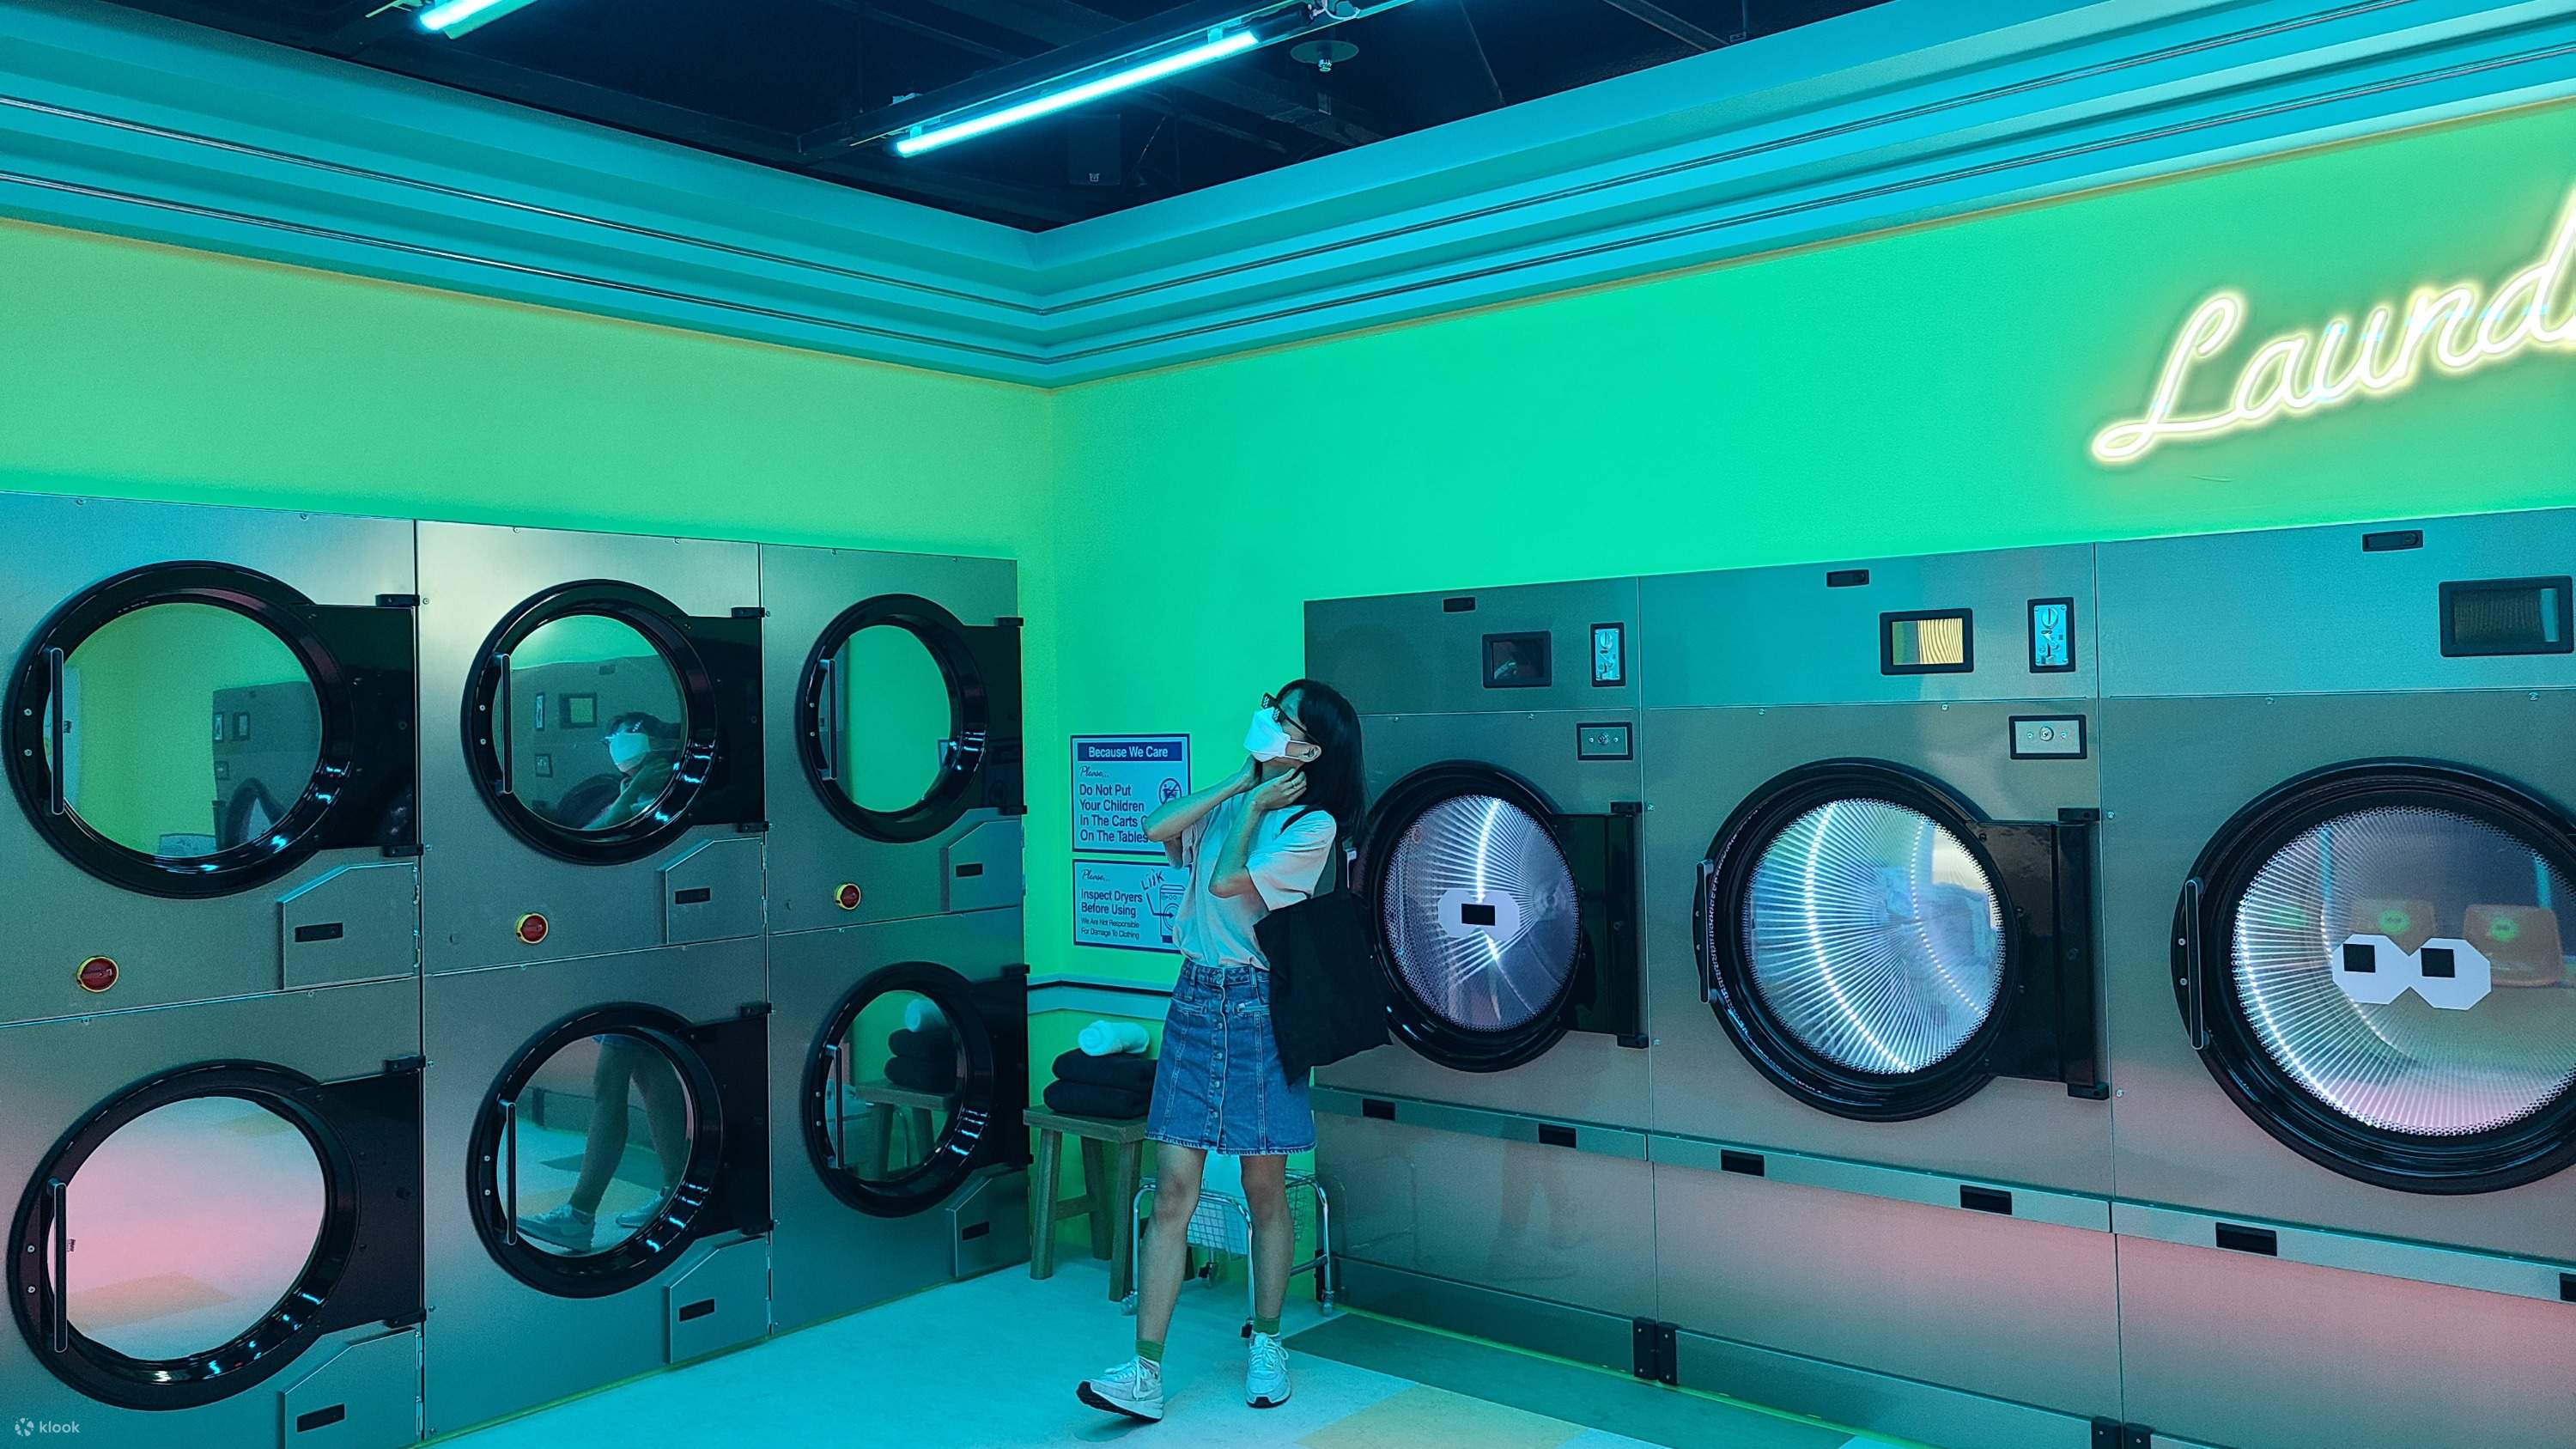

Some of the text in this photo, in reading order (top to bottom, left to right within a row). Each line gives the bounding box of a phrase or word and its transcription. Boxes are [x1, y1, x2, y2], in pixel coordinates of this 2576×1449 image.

[1089, 746, 1169, 758] Because We Care
[1079, 783, 1132, 796] Do Not Put
[1079, 799, 1145, 812] Your Children
[1080, 814, 1089, 825] In
[1091, 815, 1109, 826] The
[1112, 815, 1138, 827] Carts
[1080, 829, 1149, 843] On The Tables
[1081, 889, 1143, 904] Inspect Dryers
[1081, 902, 1136, 918] Before Using
[1091, 928, 1111, 937] Damage
[1119, 930, 1139, 941] Clothing
